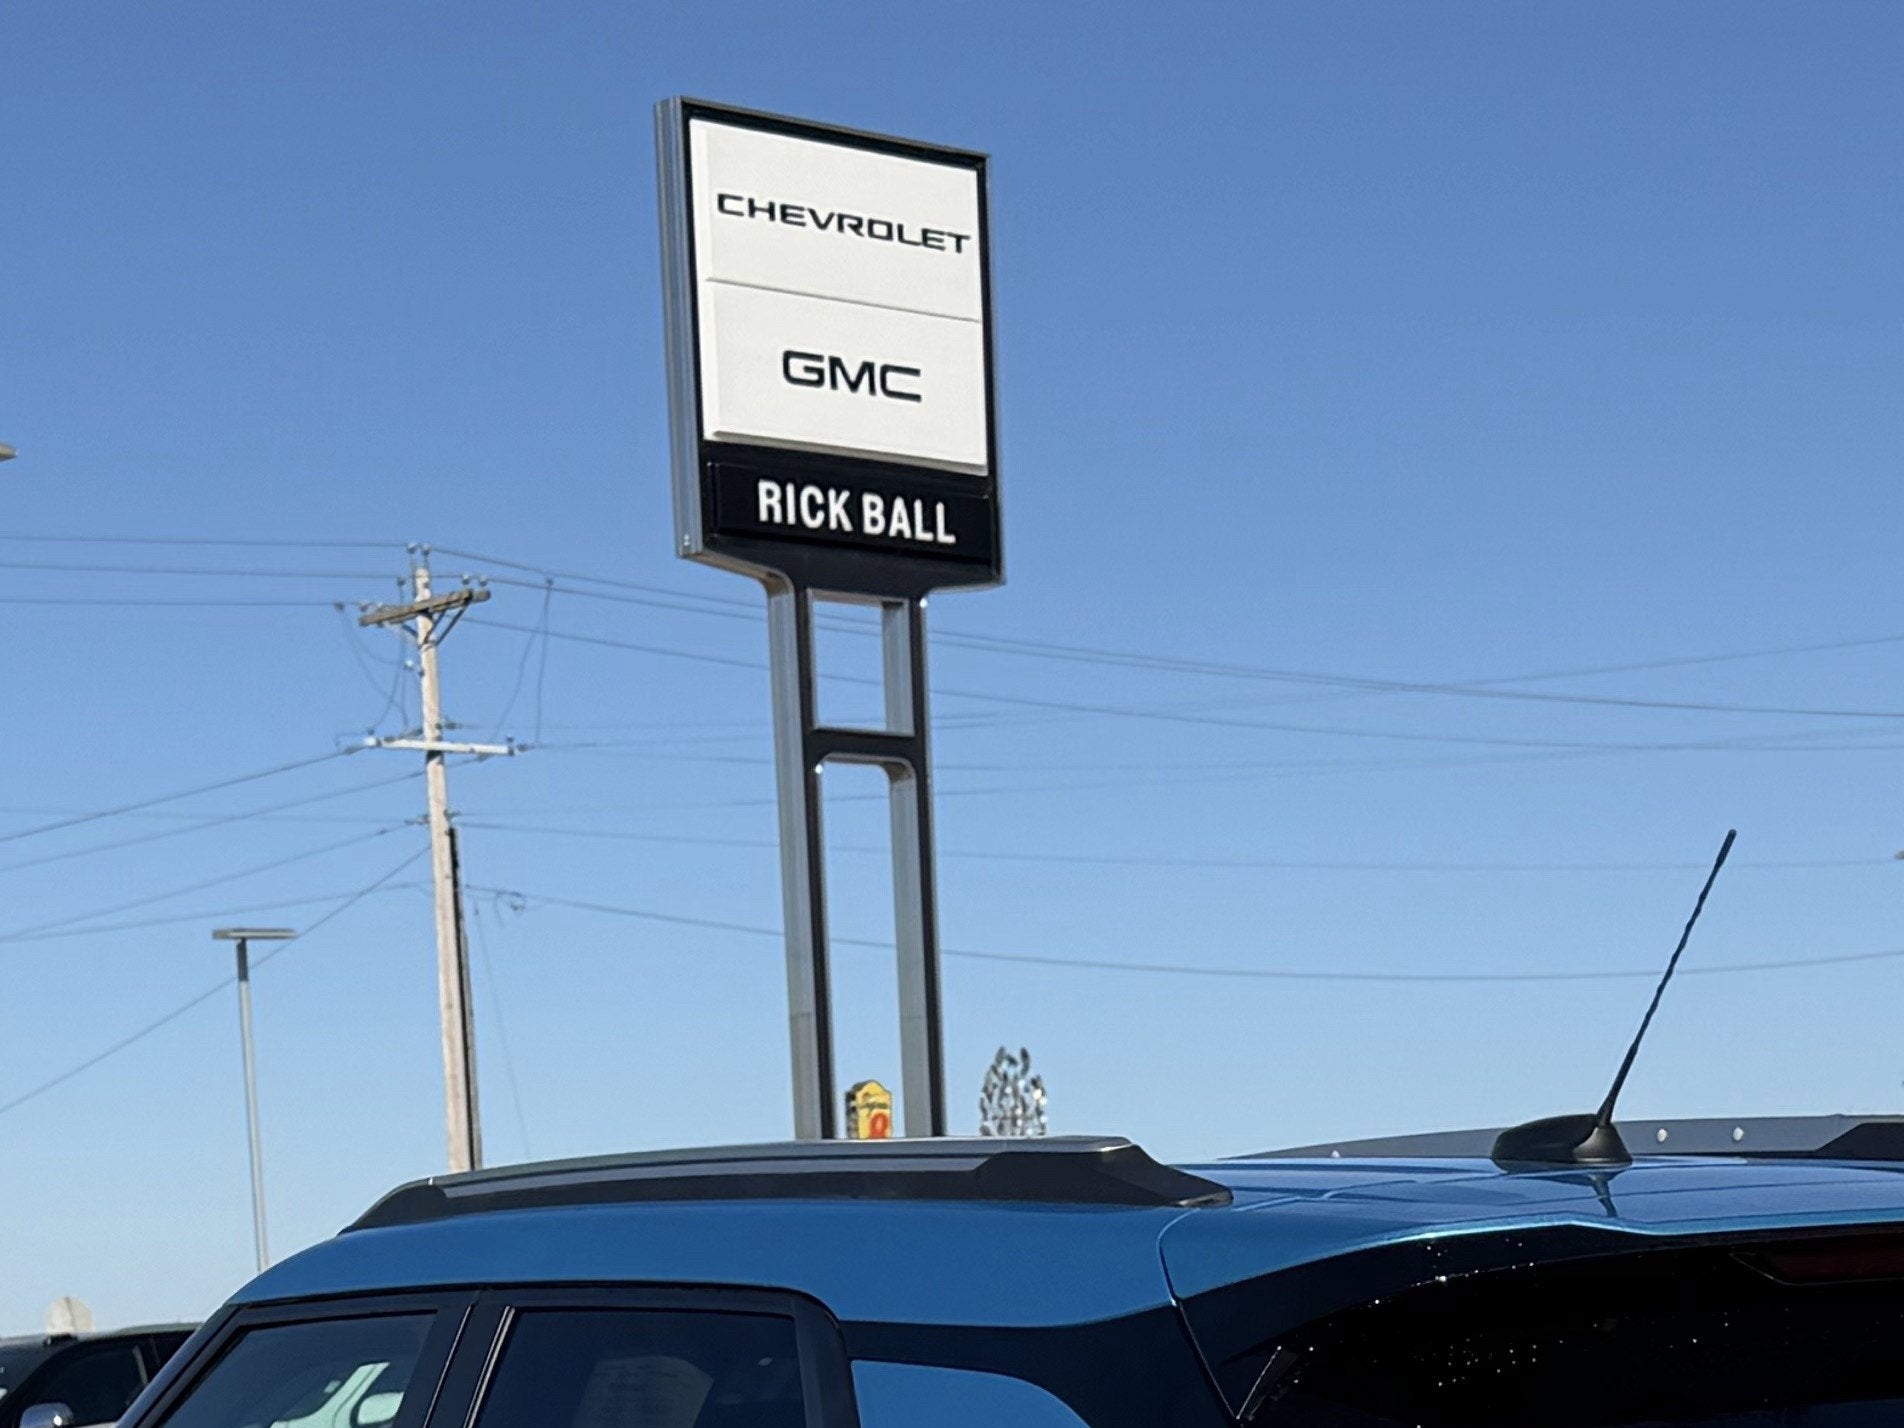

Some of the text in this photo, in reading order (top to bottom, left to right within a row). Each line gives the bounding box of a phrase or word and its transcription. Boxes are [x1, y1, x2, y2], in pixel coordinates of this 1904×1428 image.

[716, 192, 972, 255] CHEVROLET
[781, 348, 923, 403] GMC
[757, 478, 957, 545] RICK BALL
